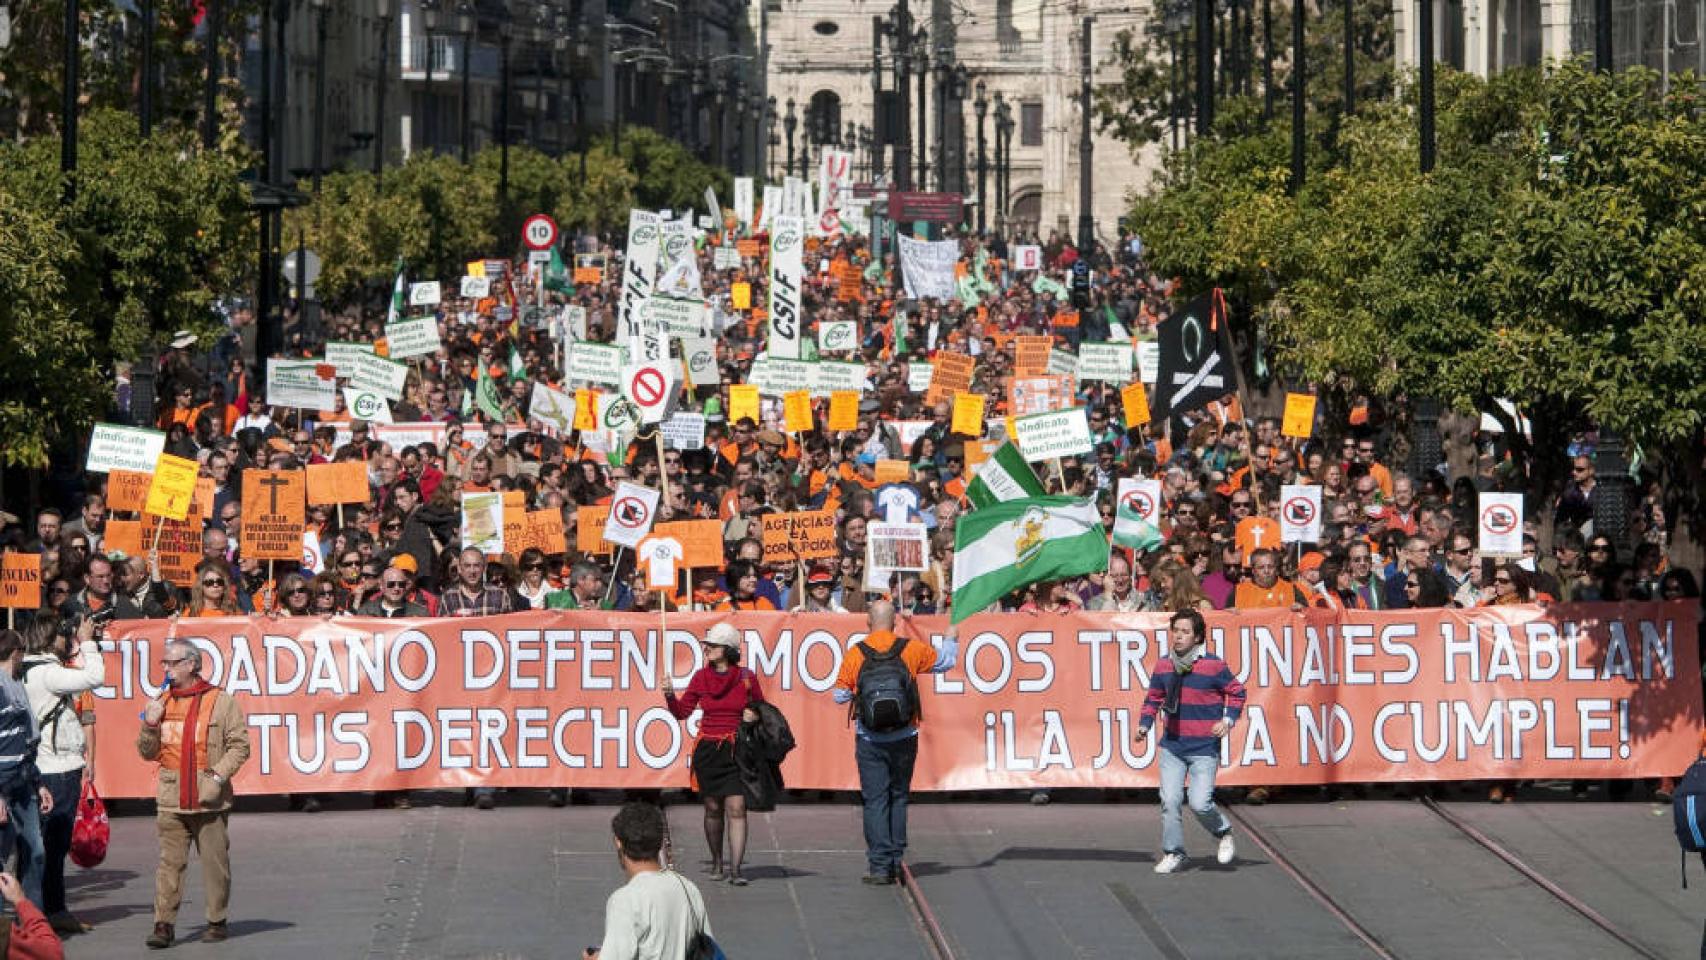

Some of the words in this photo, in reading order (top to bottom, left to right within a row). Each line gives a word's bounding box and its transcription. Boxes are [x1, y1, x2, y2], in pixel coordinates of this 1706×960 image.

[532, 226, 548, 239] 10
[1018, 416, 1069, 432] sindicato
[460, 629, 869, 693] DEFENDMO
[931, 630, 1055, 694] LOS
[1440, 620, 1675, 684] HABLAN
[247, 711, 371, 775] TUS
[1295, 701, 1354, 765] NO
[1372, 699, 1631, 763] CUMPLE!
